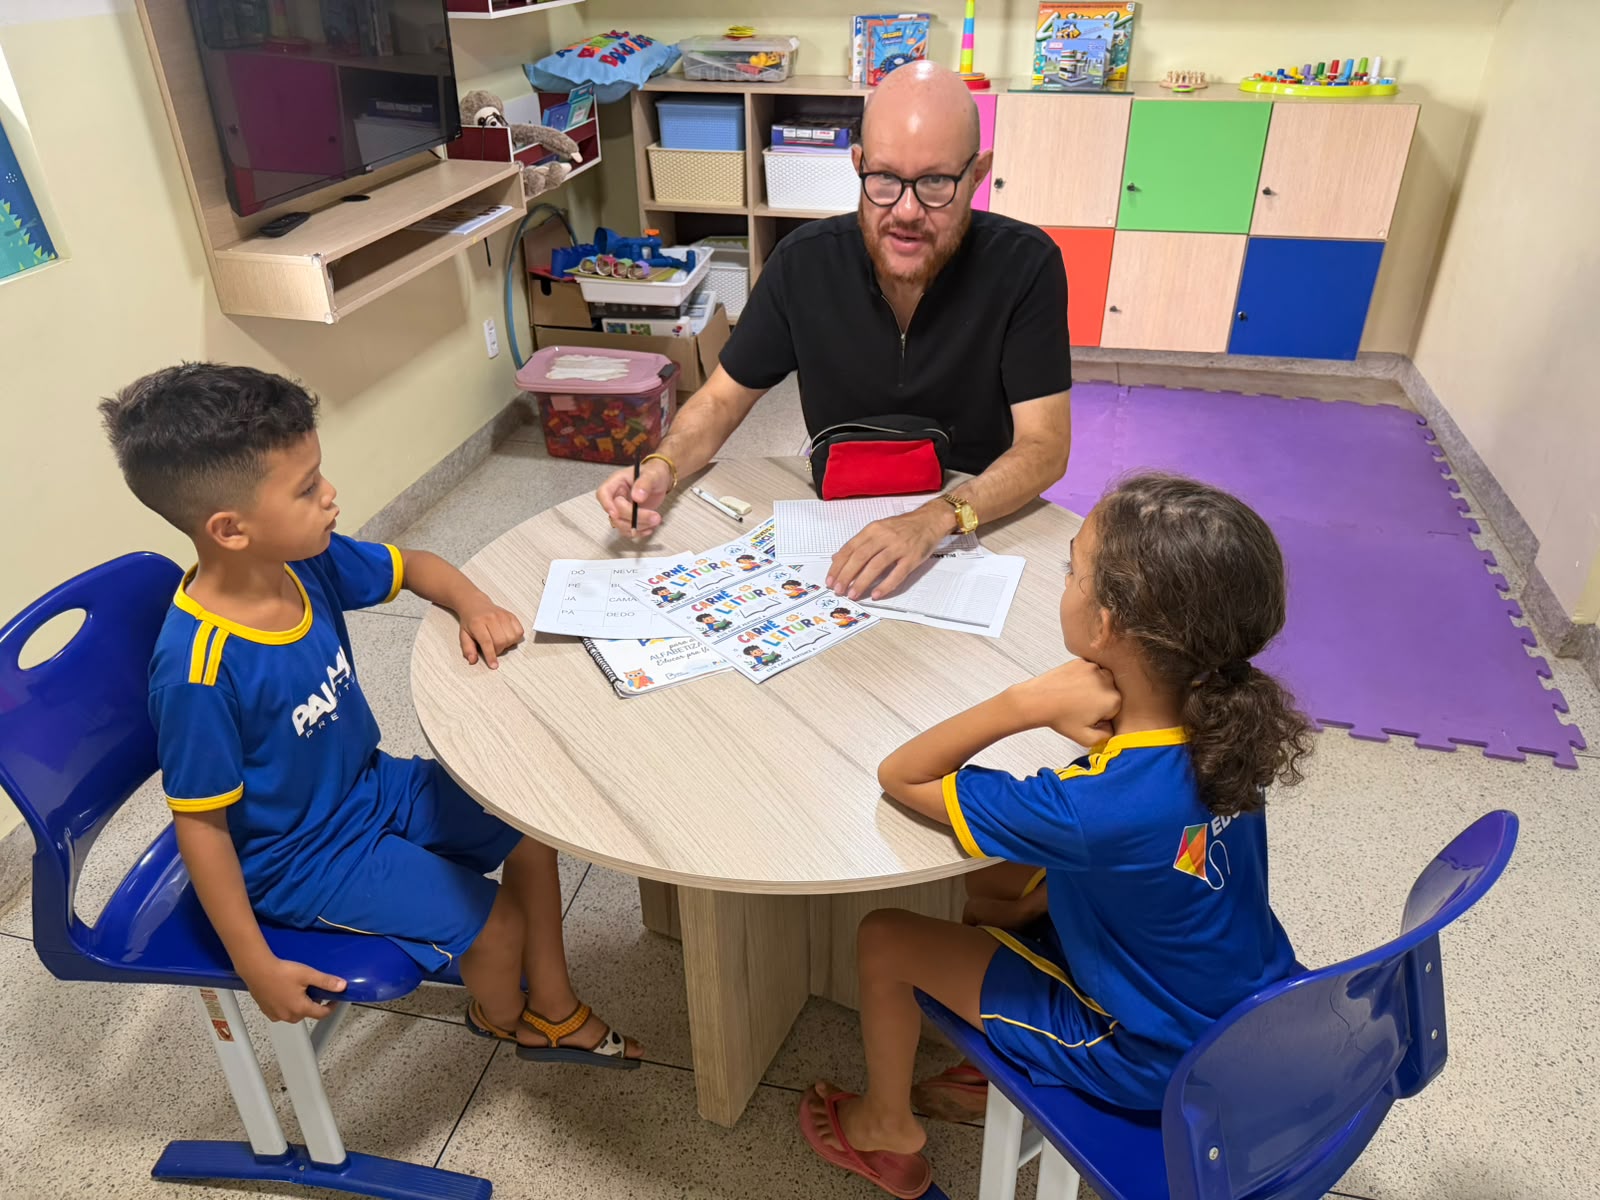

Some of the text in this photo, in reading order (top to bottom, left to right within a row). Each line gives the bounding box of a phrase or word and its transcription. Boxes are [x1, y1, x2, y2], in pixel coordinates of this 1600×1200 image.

[670, 560, 732, 587] LEITURA
[714, 587, 778, 614] LEITURA
[761, 616, 827, 647] LEITURA
